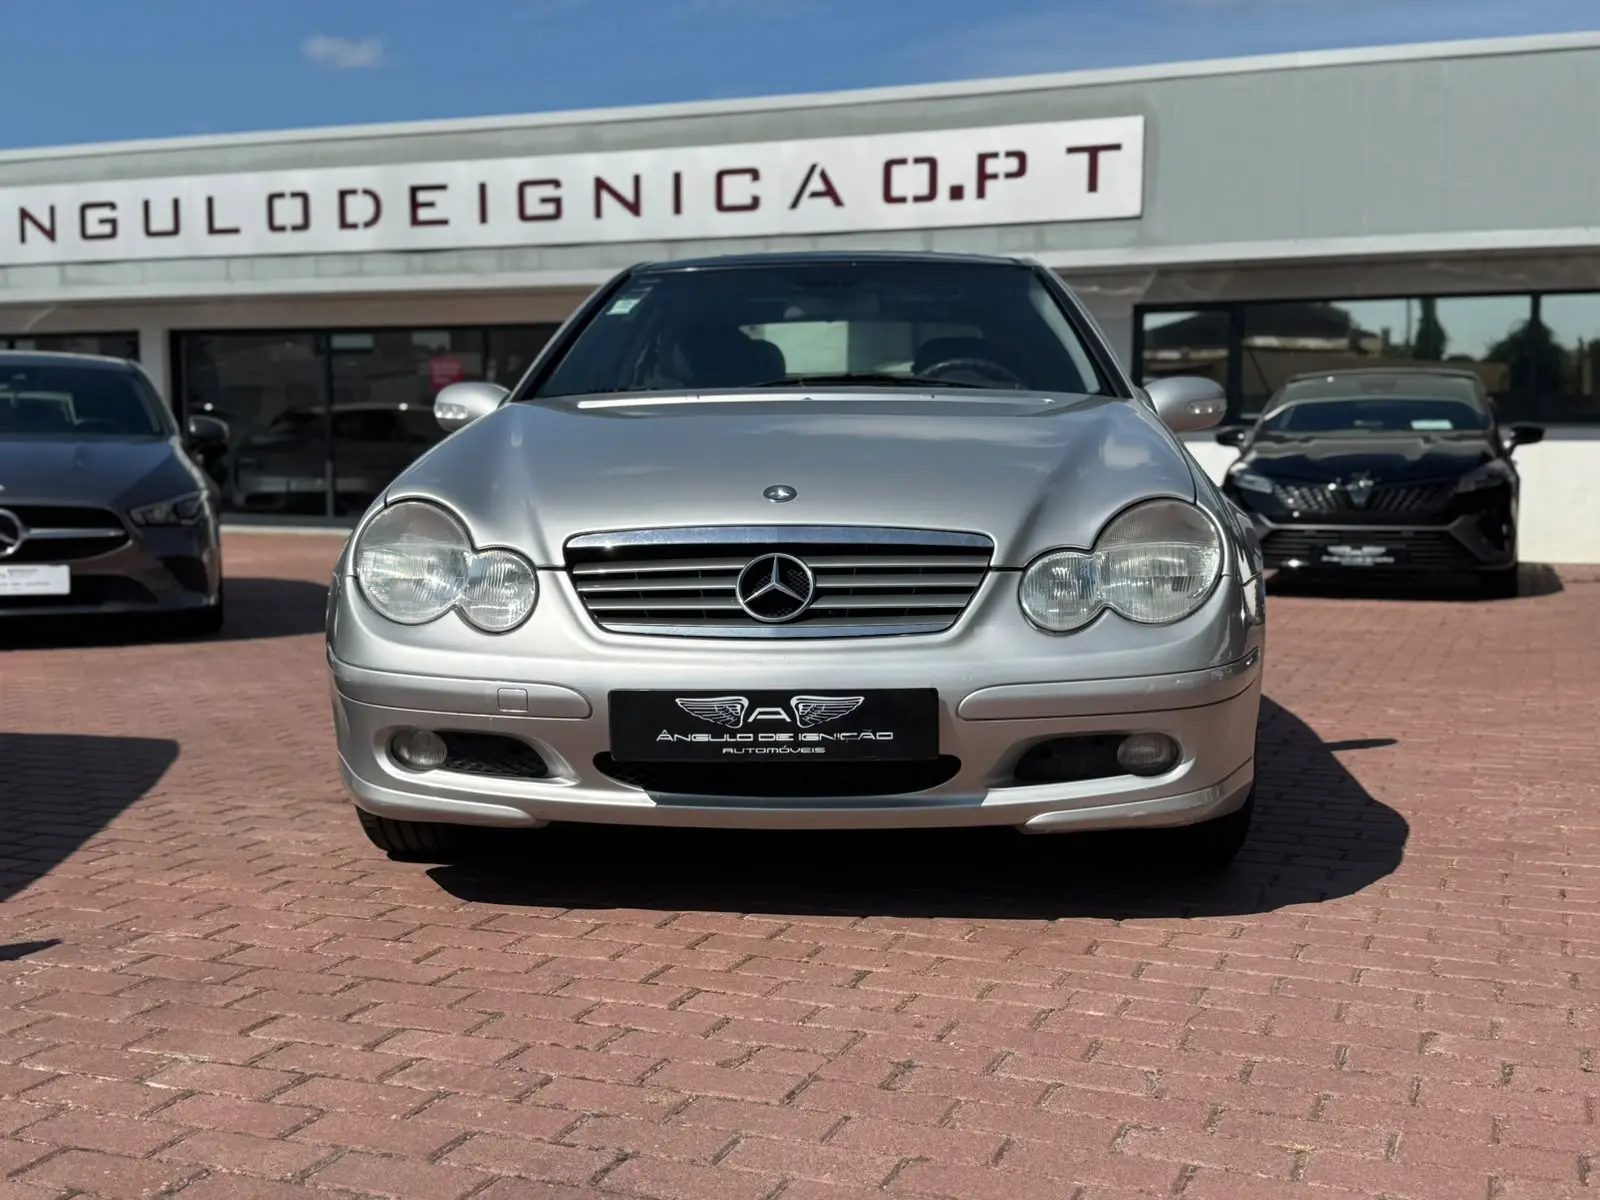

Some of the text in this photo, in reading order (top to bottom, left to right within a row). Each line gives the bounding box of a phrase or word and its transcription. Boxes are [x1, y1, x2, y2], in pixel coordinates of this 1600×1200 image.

[655, 728, 894, 743] ÂNGULO DE IGNIÇÃO
[722, 745, 826, 754] AUTOMÓVEIS
